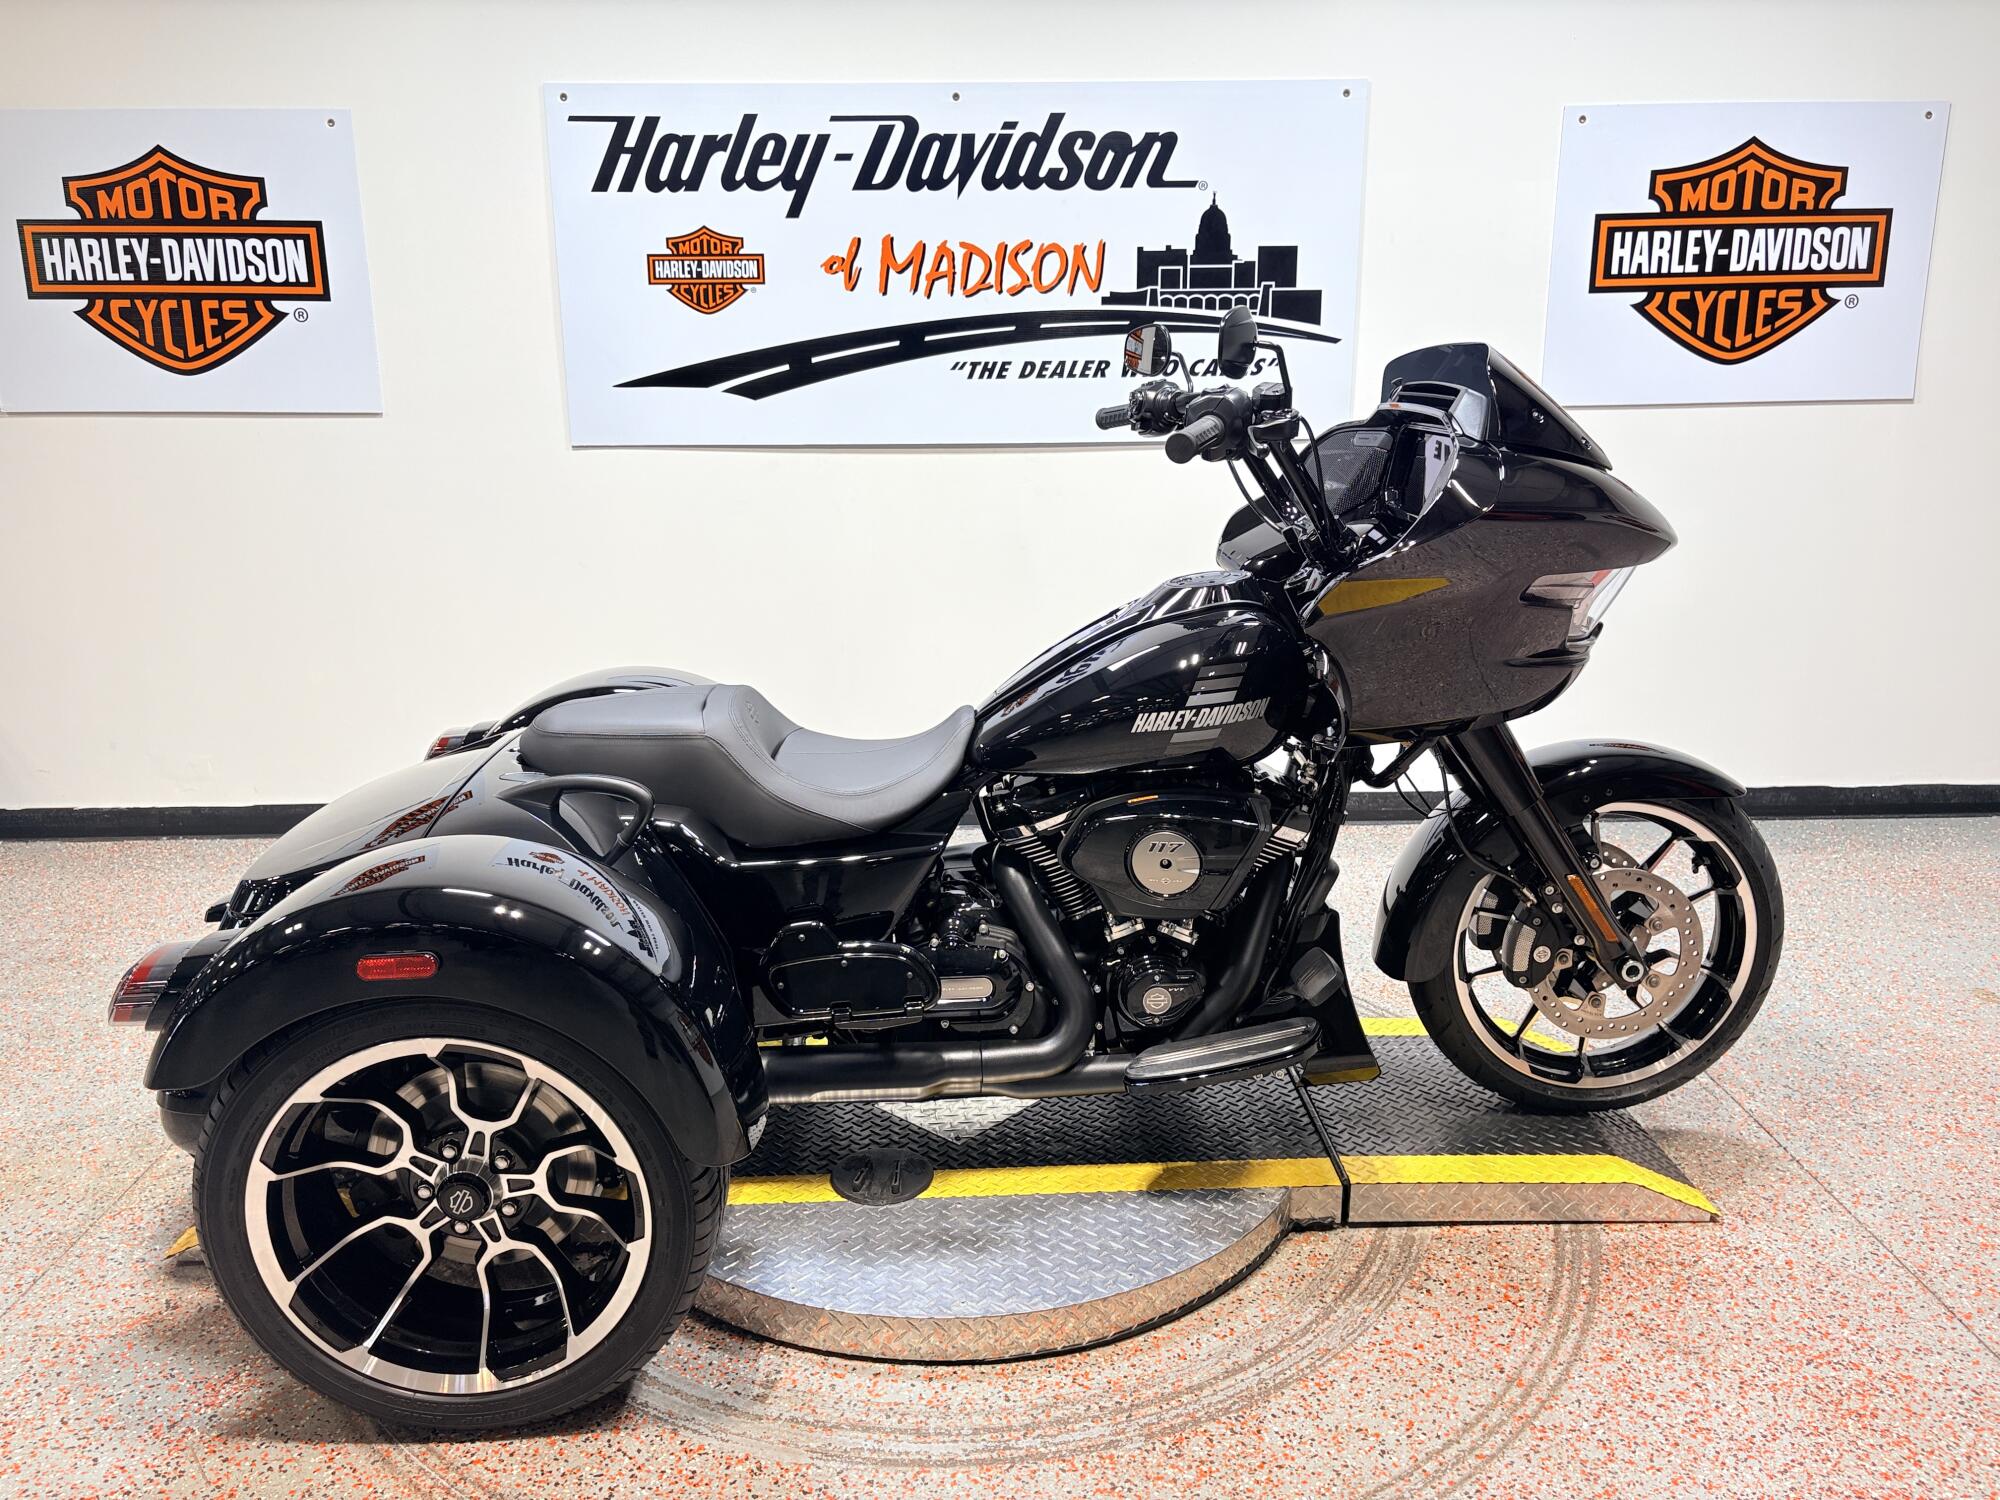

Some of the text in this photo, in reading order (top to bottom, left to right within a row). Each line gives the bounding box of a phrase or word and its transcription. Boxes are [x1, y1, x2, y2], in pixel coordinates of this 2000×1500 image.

[567, 112, 1198, 219] Harley-Davidson
[1679, 158, 1817, 212] MOTOR
[96, 167, 237, 220] MOTOR
[40, 237, 309, 283] HARLEY-DAVIDSON
[678, 234, 733, 255] MOTOR
[878, 233, 1106, 300] MADISON
[1610, 226, 1873, 276] HARLEY-DAVIDSON
[654, 260, 758, 279] HARLEY-DAVIDSON
[680, 284, 734, 309] CYCLES
[1667, 288, 1804, 349] CYCLES
[110, 298, 249, 359] CYCLES
[1018, 360, 1111, 379] DEALER
[1130, 697, 1271, 733] HARLEY-DAVIDSON
[1148, 842, 1185, 853] 117
